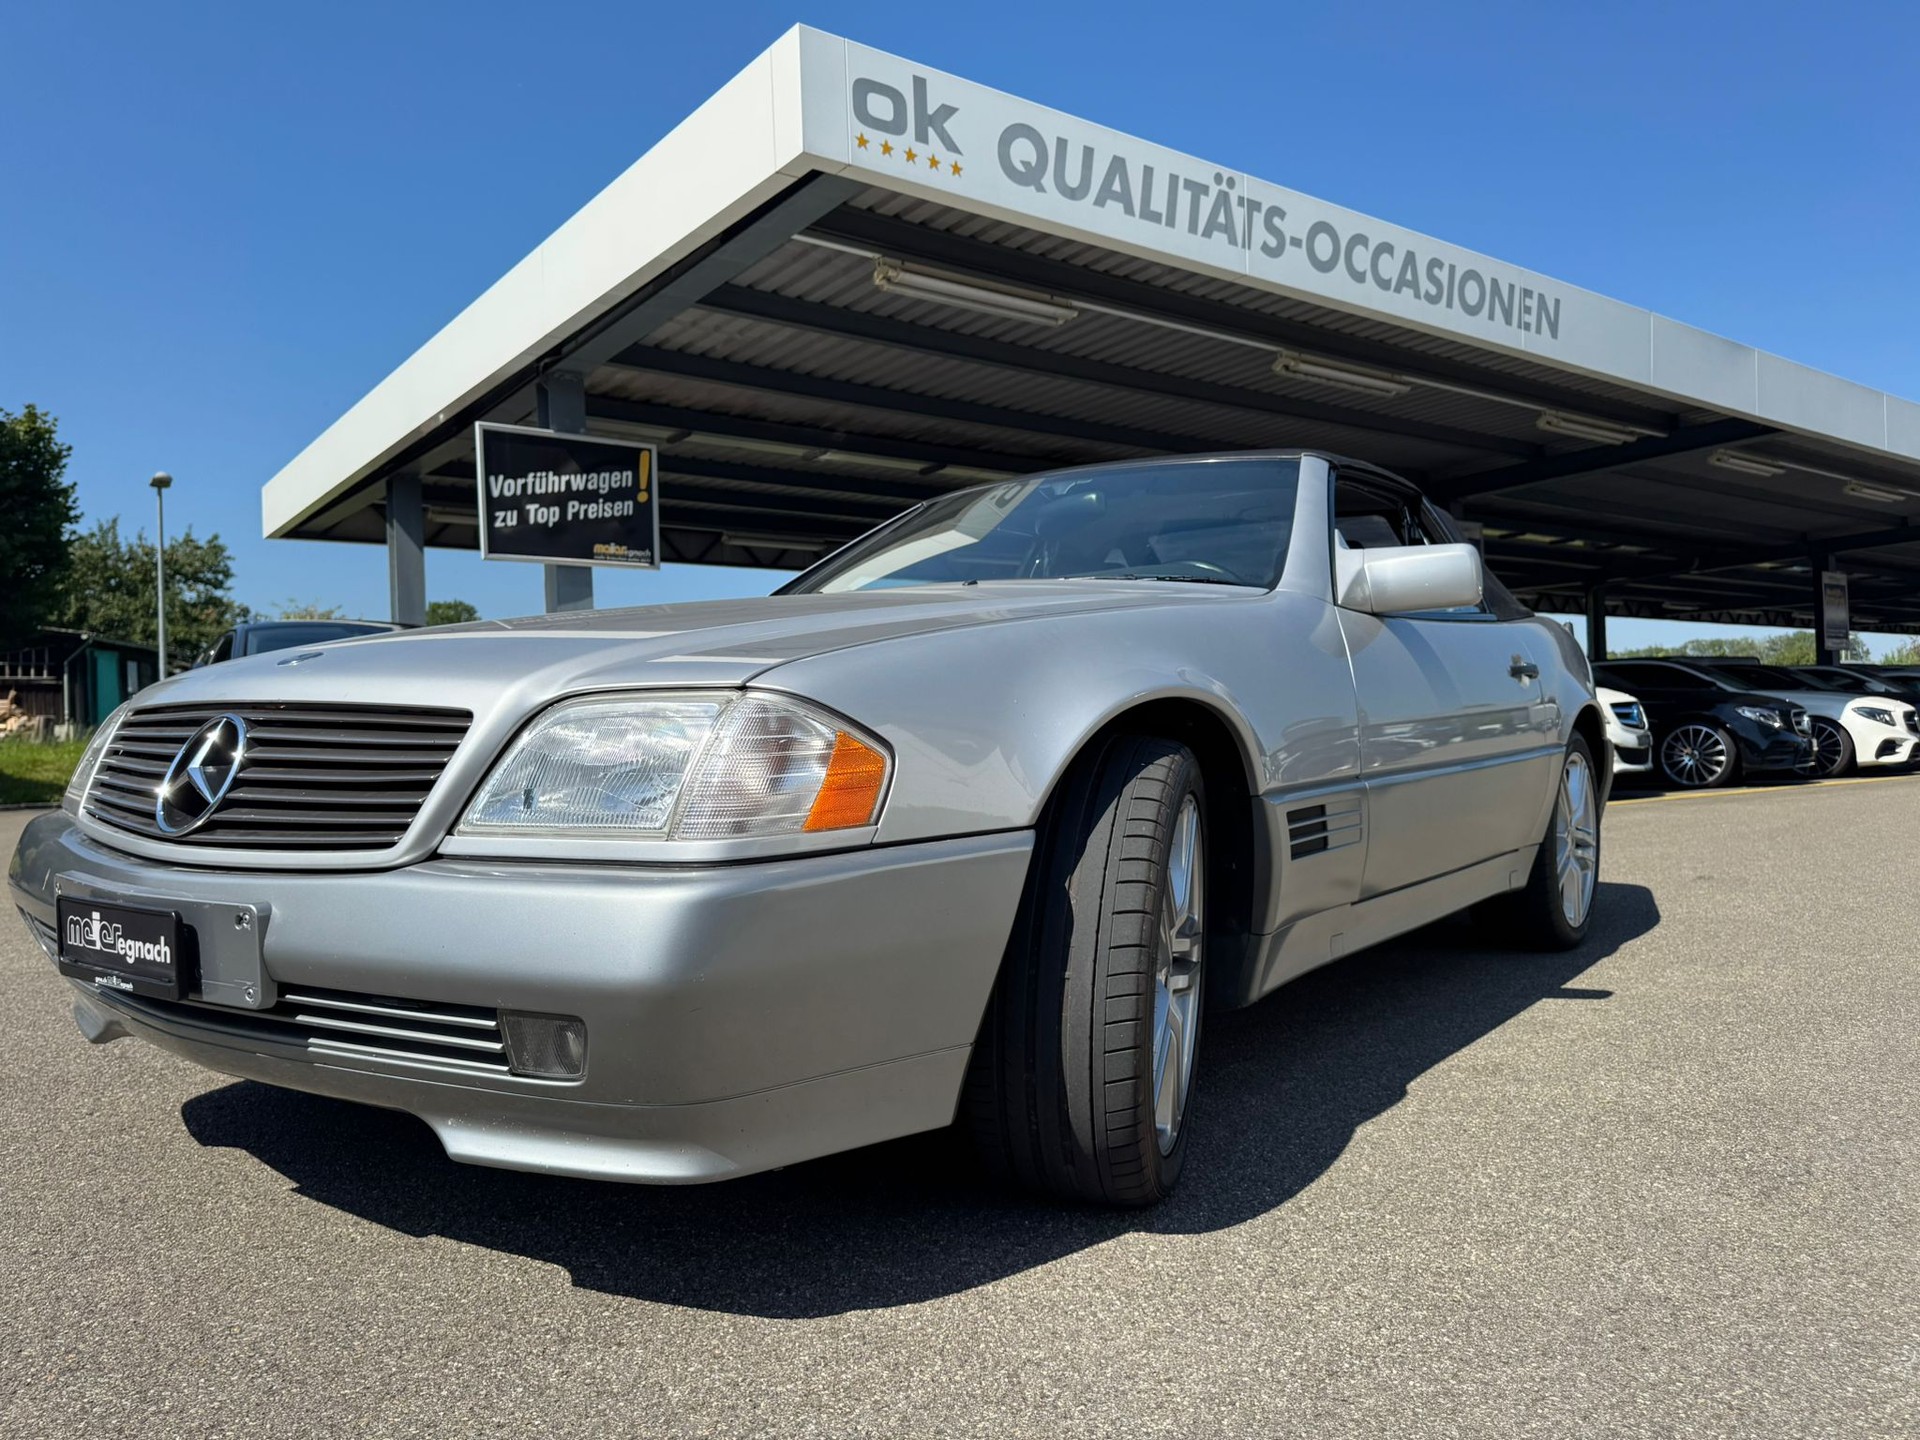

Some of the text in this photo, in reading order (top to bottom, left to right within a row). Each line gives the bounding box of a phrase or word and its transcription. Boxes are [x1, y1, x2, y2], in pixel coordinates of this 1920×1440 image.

[852, 74, 1561, 340] ok QUALITÄTS-OCCASIONEN
[489, 470, 633, 499] Vorführwagen
[494, 498, 634, 528] zu Top Preisen
